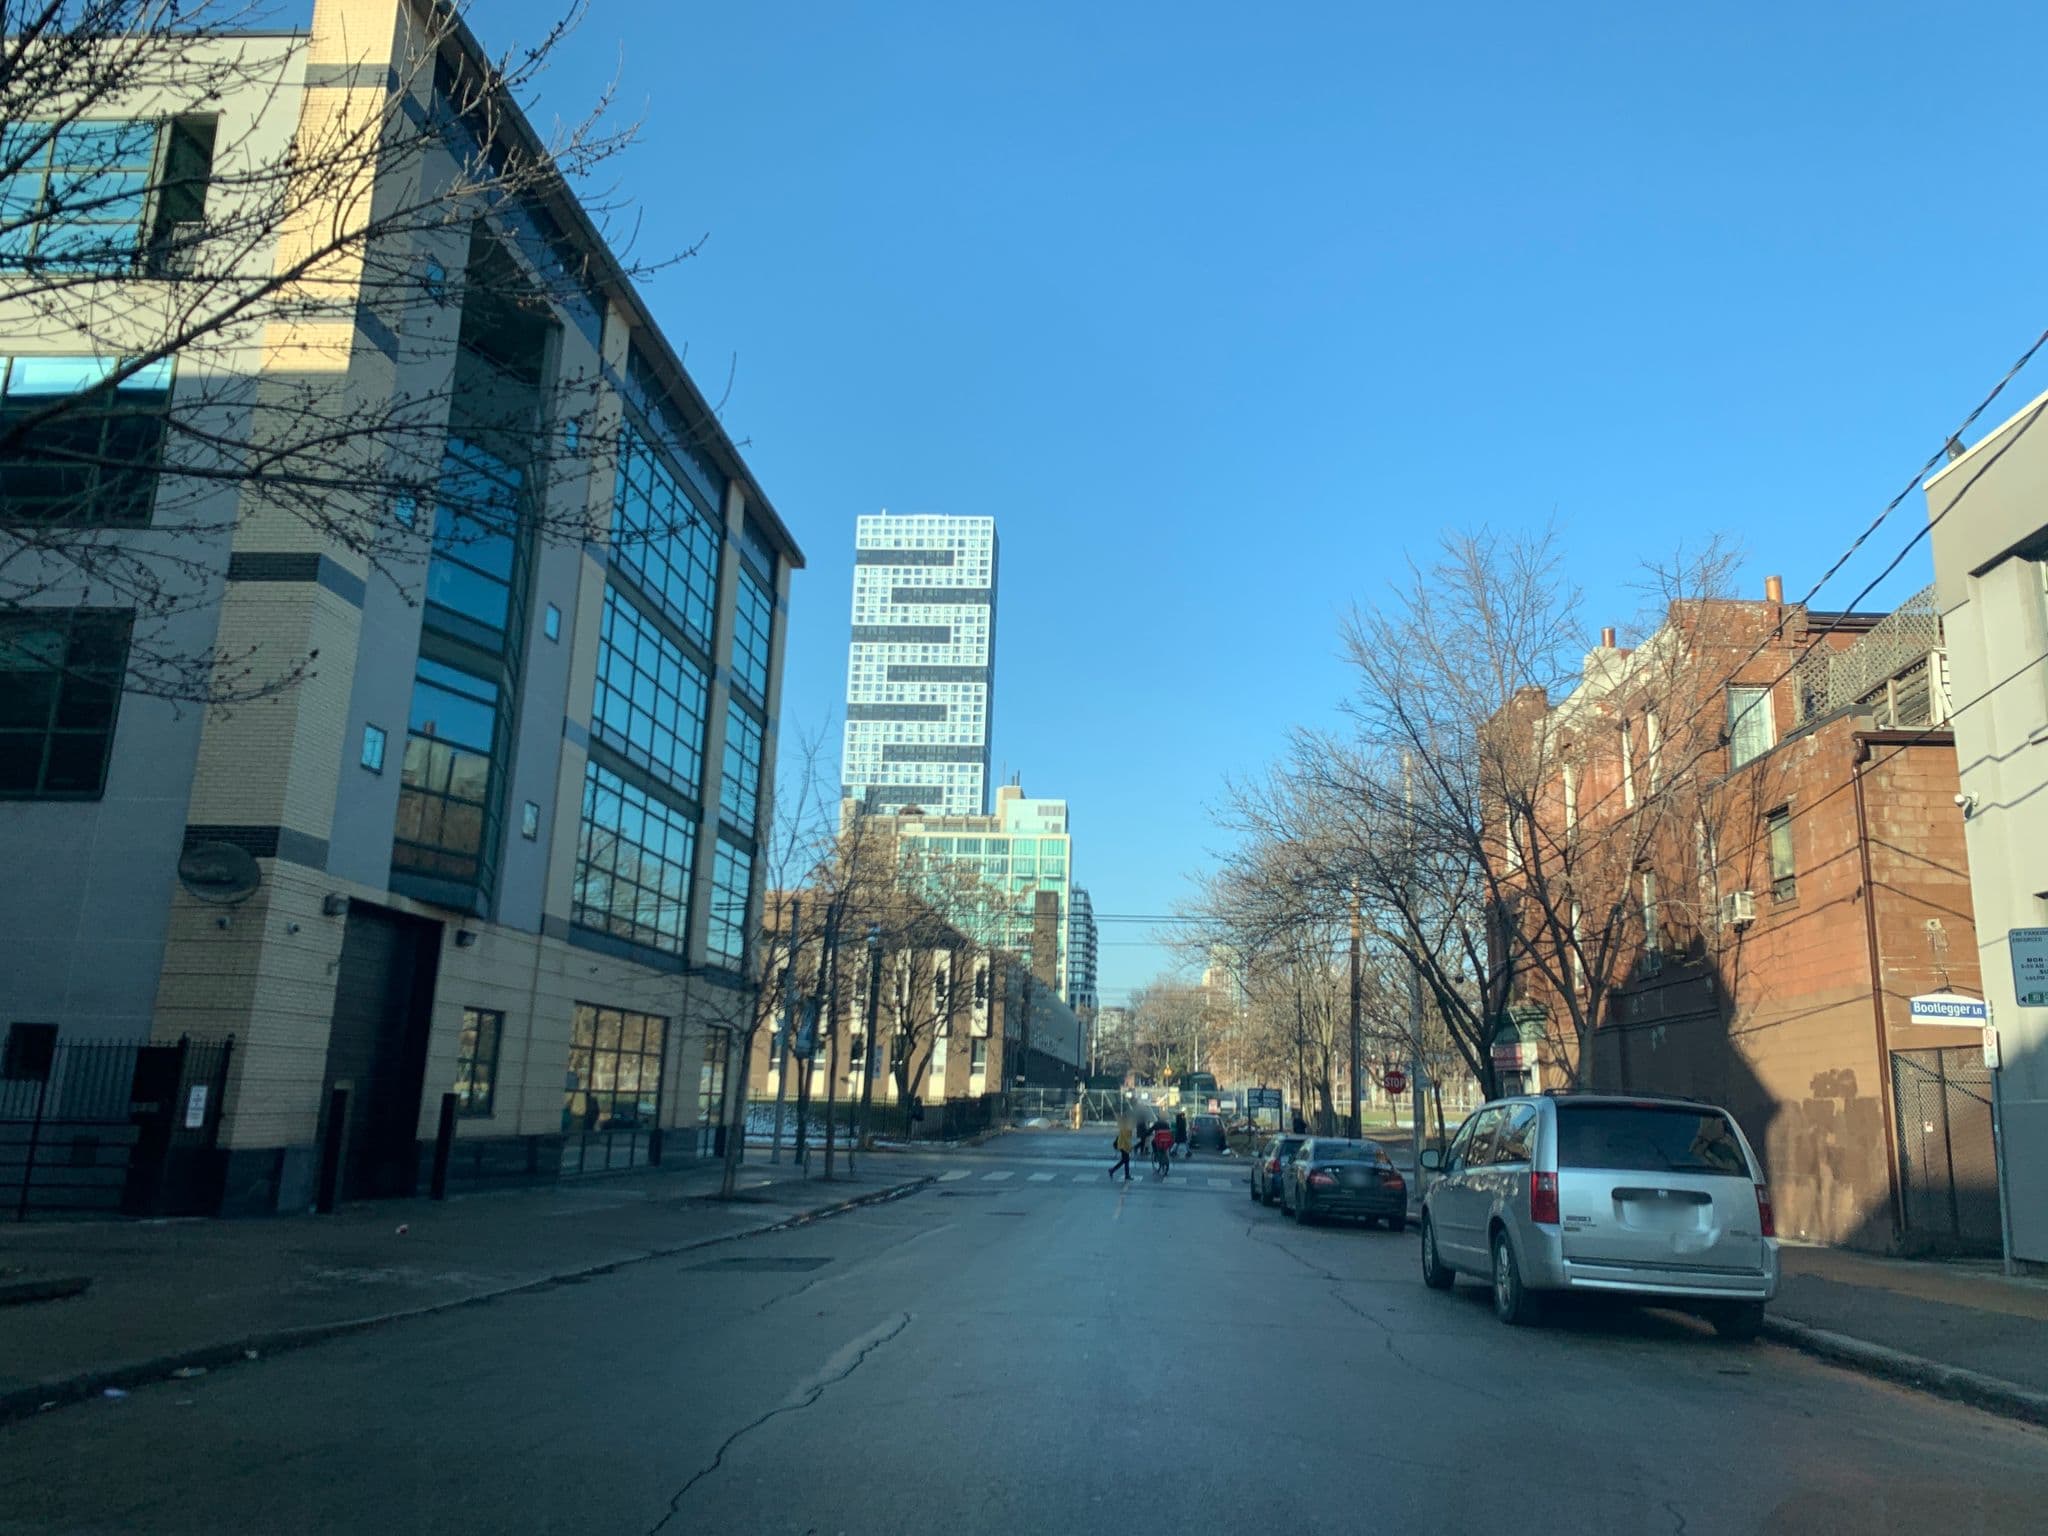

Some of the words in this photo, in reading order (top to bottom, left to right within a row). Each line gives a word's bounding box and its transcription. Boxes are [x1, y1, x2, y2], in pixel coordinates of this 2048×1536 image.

[1913, 1002, 1971, 1017] Bootlegger
[1973, 1007, 1983, 1015] Ln
[1384, 1077, 1405, 1089] STOP
